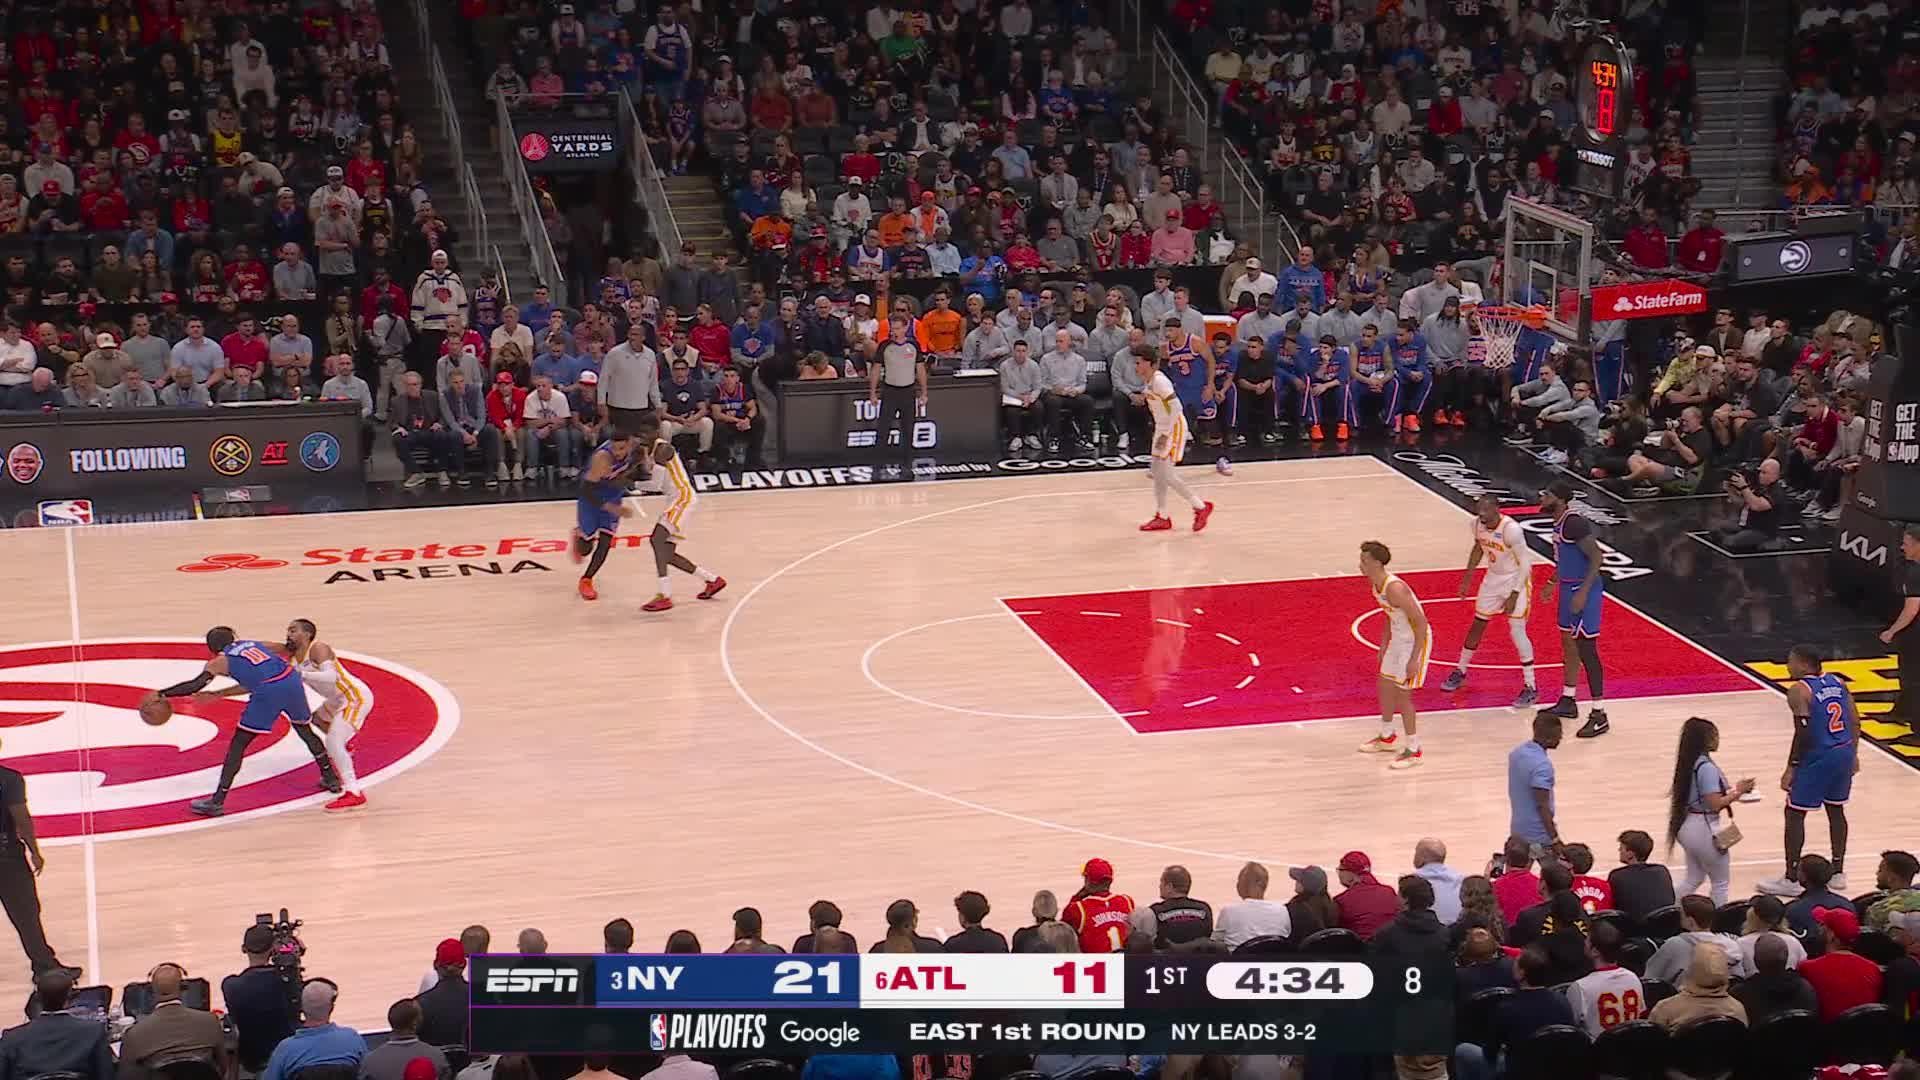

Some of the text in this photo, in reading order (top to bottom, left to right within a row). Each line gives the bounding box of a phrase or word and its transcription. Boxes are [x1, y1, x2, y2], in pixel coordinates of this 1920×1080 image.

[551, 134, 612, 143] CENTENNIAL
[552, 142, 613, 152] YARDS
[1895, 404, 1918, 422] GET
[1895, 423, 1916, 440] THE
[70, 446, 186, 473] FOLLOWING
[263, 441, 288, 459] AT
[1898, 442, 1919, 463] App
[692, 466, 873, 491] PLAYOFFS
[968, 462, 992, 472] by
[301, 534, 652, 566] State Fam
[324, 559, 552, 584] ARENA
[1827, 701, 1845, 732] 2
[1107, 926, 1122, 952] 1
[1597, 989, 1639, 1030] 68
